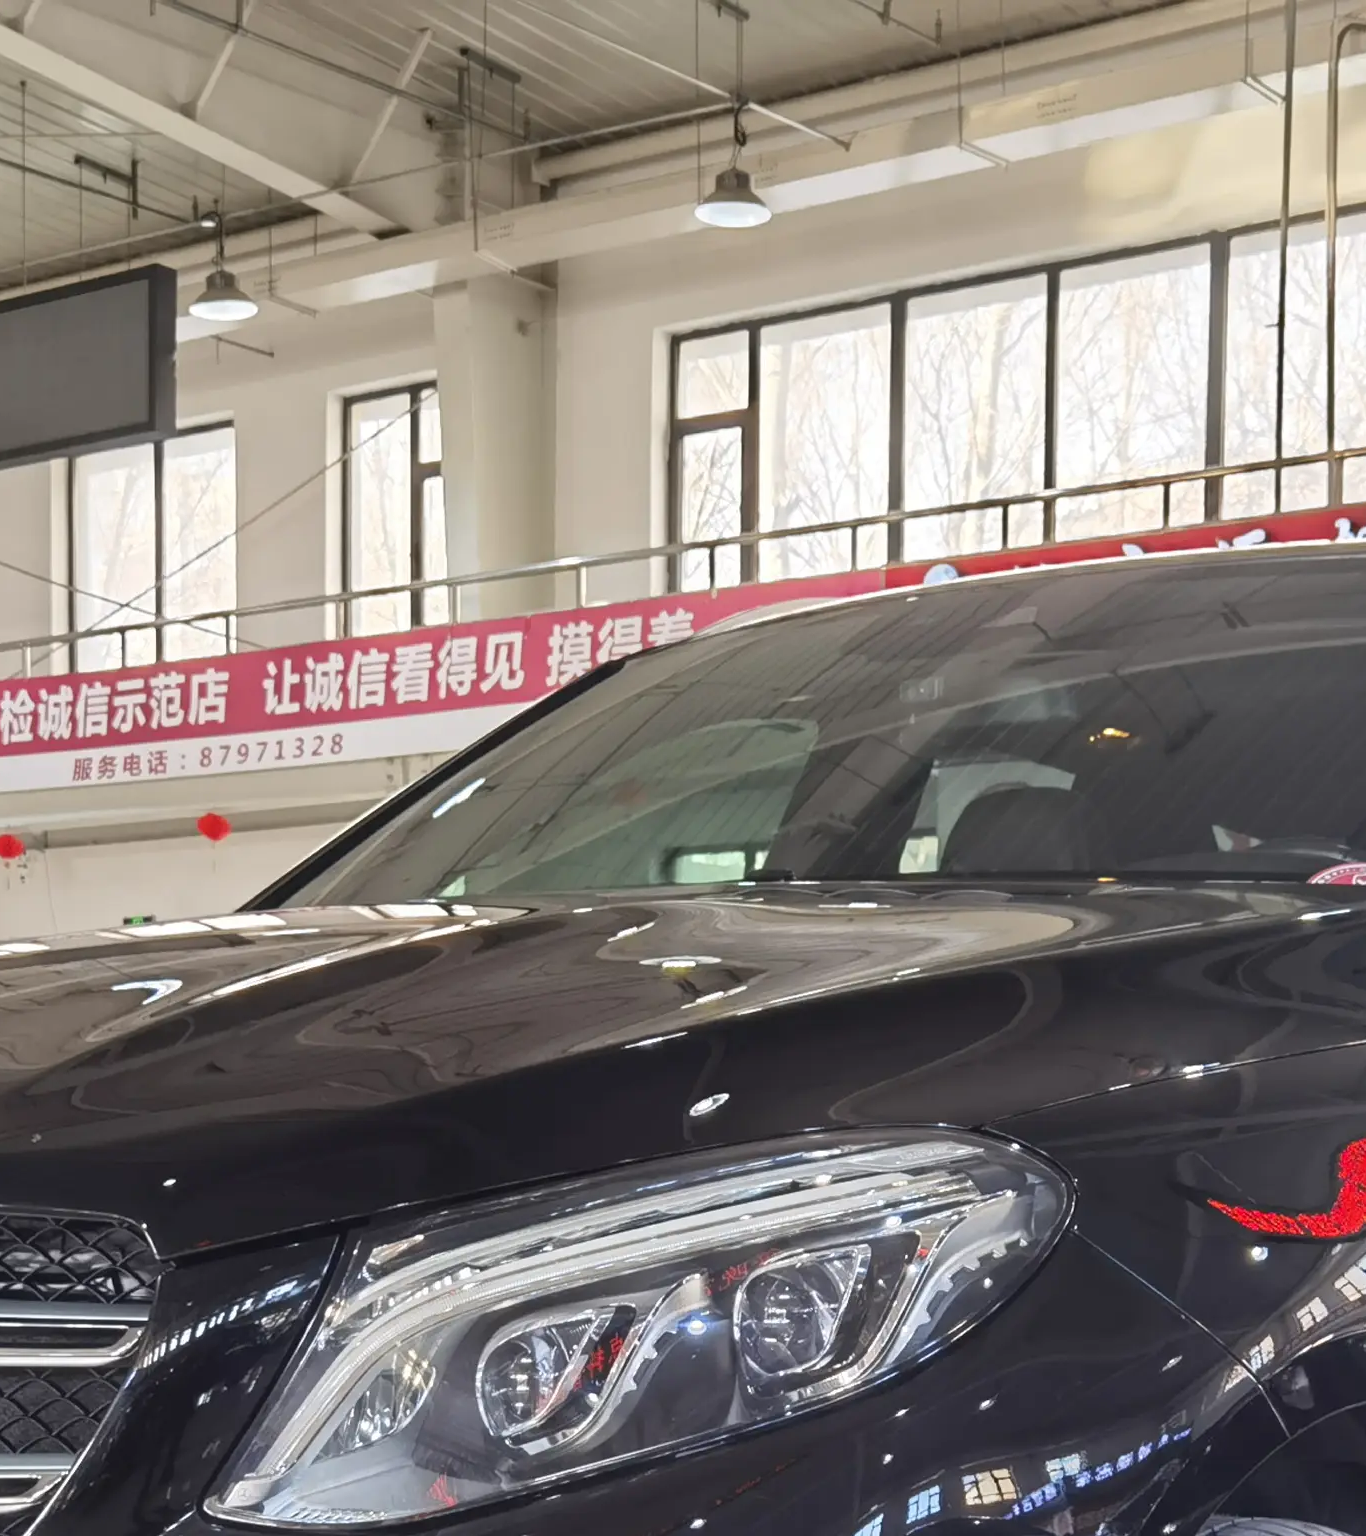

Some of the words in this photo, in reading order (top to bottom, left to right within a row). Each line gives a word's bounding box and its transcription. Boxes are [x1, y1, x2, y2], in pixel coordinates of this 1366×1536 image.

[262, 631, 526, 717] 让诚信看得见
